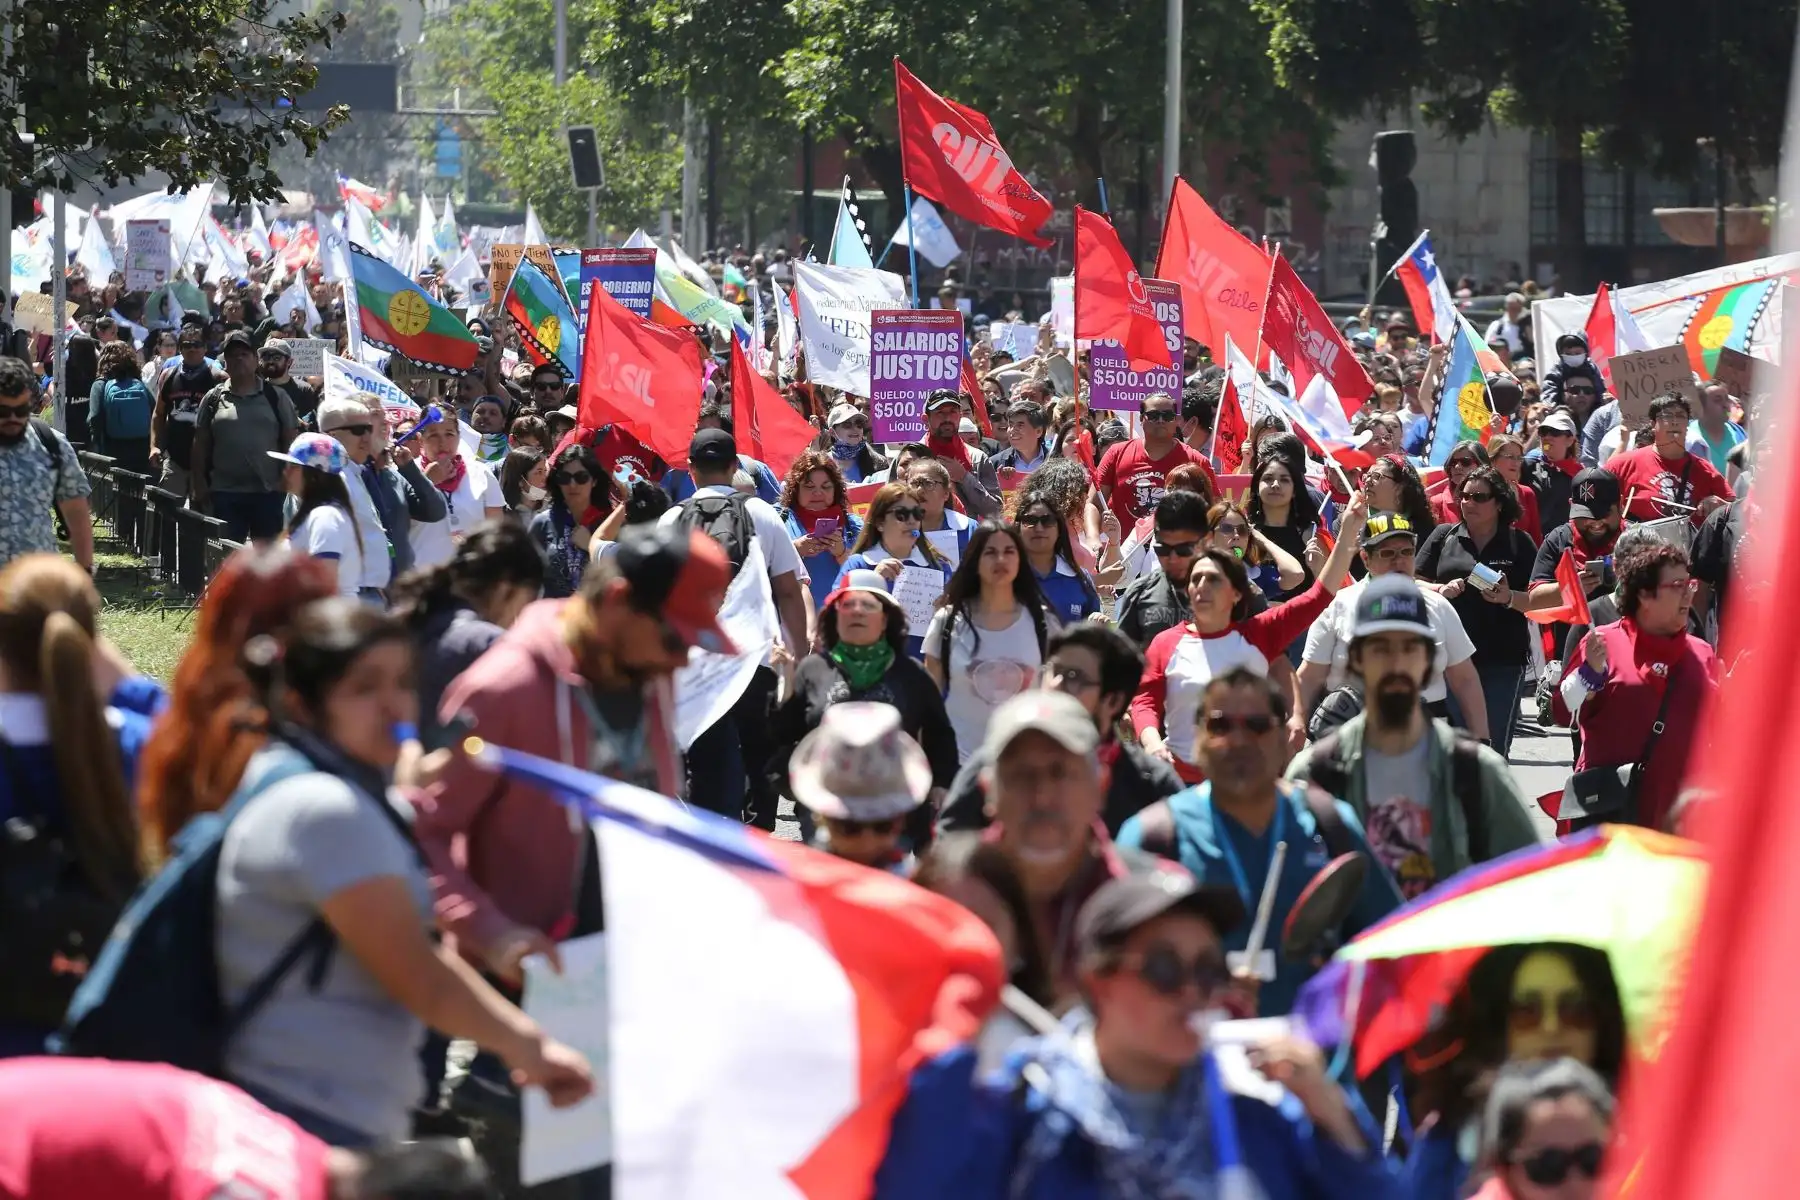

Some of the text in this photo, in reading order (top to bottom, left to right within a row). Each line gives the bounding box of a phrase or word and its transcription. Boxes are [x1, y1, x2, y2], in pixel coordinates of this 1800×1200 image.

[931, 122, 1014, 193] CUT
[1217, 289, 1259, 312] Chile
[873, 331, 959, 353] SALARIOS
[1094, 357, 1129, 369] SUELD
[1308, 330, 1340, 378] SIL
[873, 353, 959, 381] JUSTOS
[343, 372, 416, 407] CONFED
[612, 363, 655, 408] SIL
[1093, 368, 1179, 389] $500.000
[873, 390, 915, 400] SUELDO
[1110, 388, 1147, 401] LÍQUID
[874, 401, 922, 420] $500.
